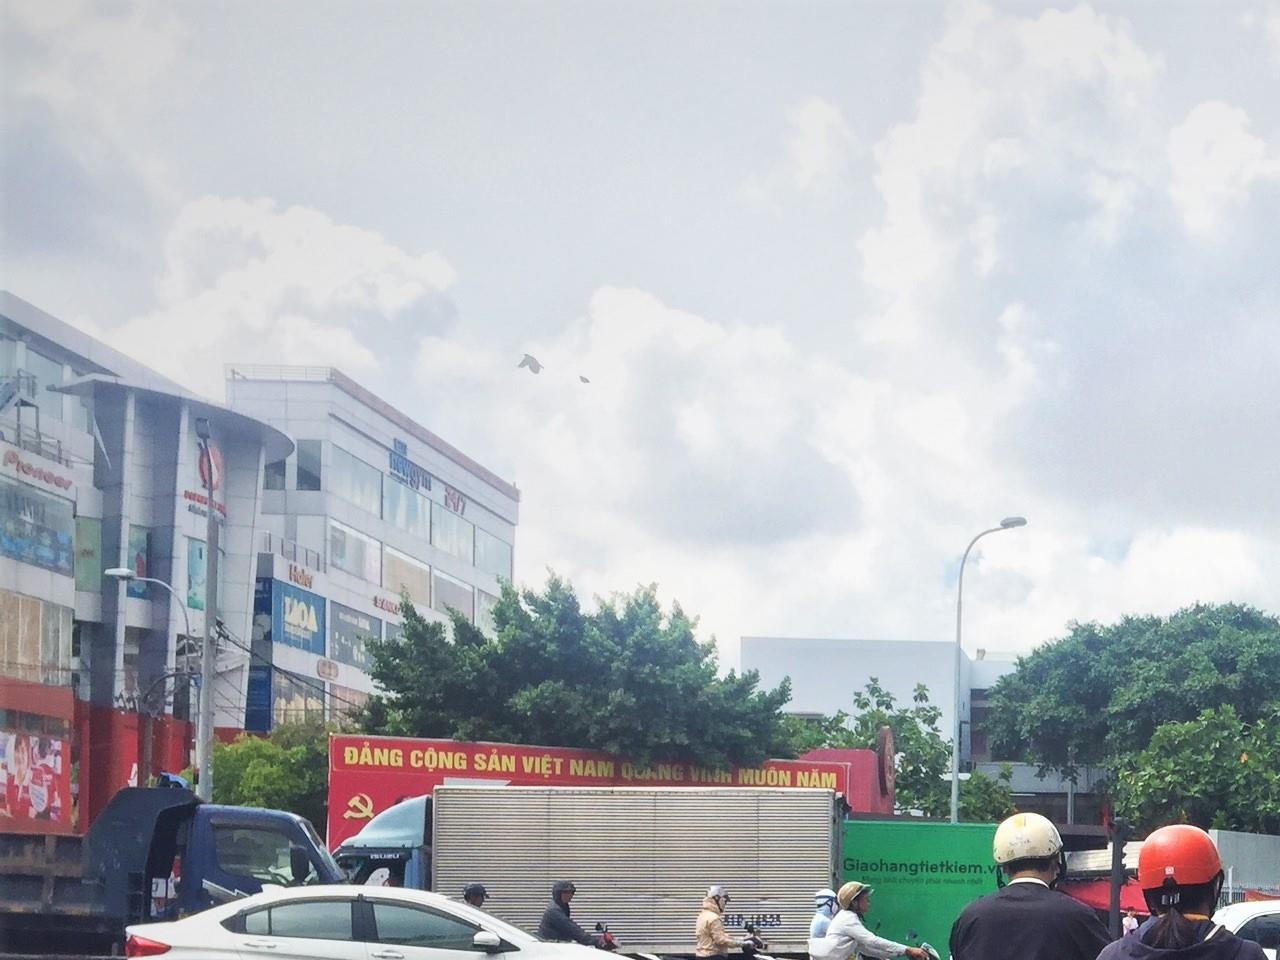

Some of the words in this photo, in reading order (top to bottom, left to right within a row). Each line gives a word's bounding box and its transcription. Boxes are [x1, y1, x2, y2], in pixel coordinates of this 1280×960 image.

[344, 741, 403, 767] ĐẢNG
[410, 747, 467, 772] CỘNG
[474, 749, 516, 772] SẢN
[522, 754, 564, 778] VIỆT
[569, 759, 615, 778] NAM
[739, 766, 791, 786] MUÔN
[796, 768, 837, 788] NĂM
